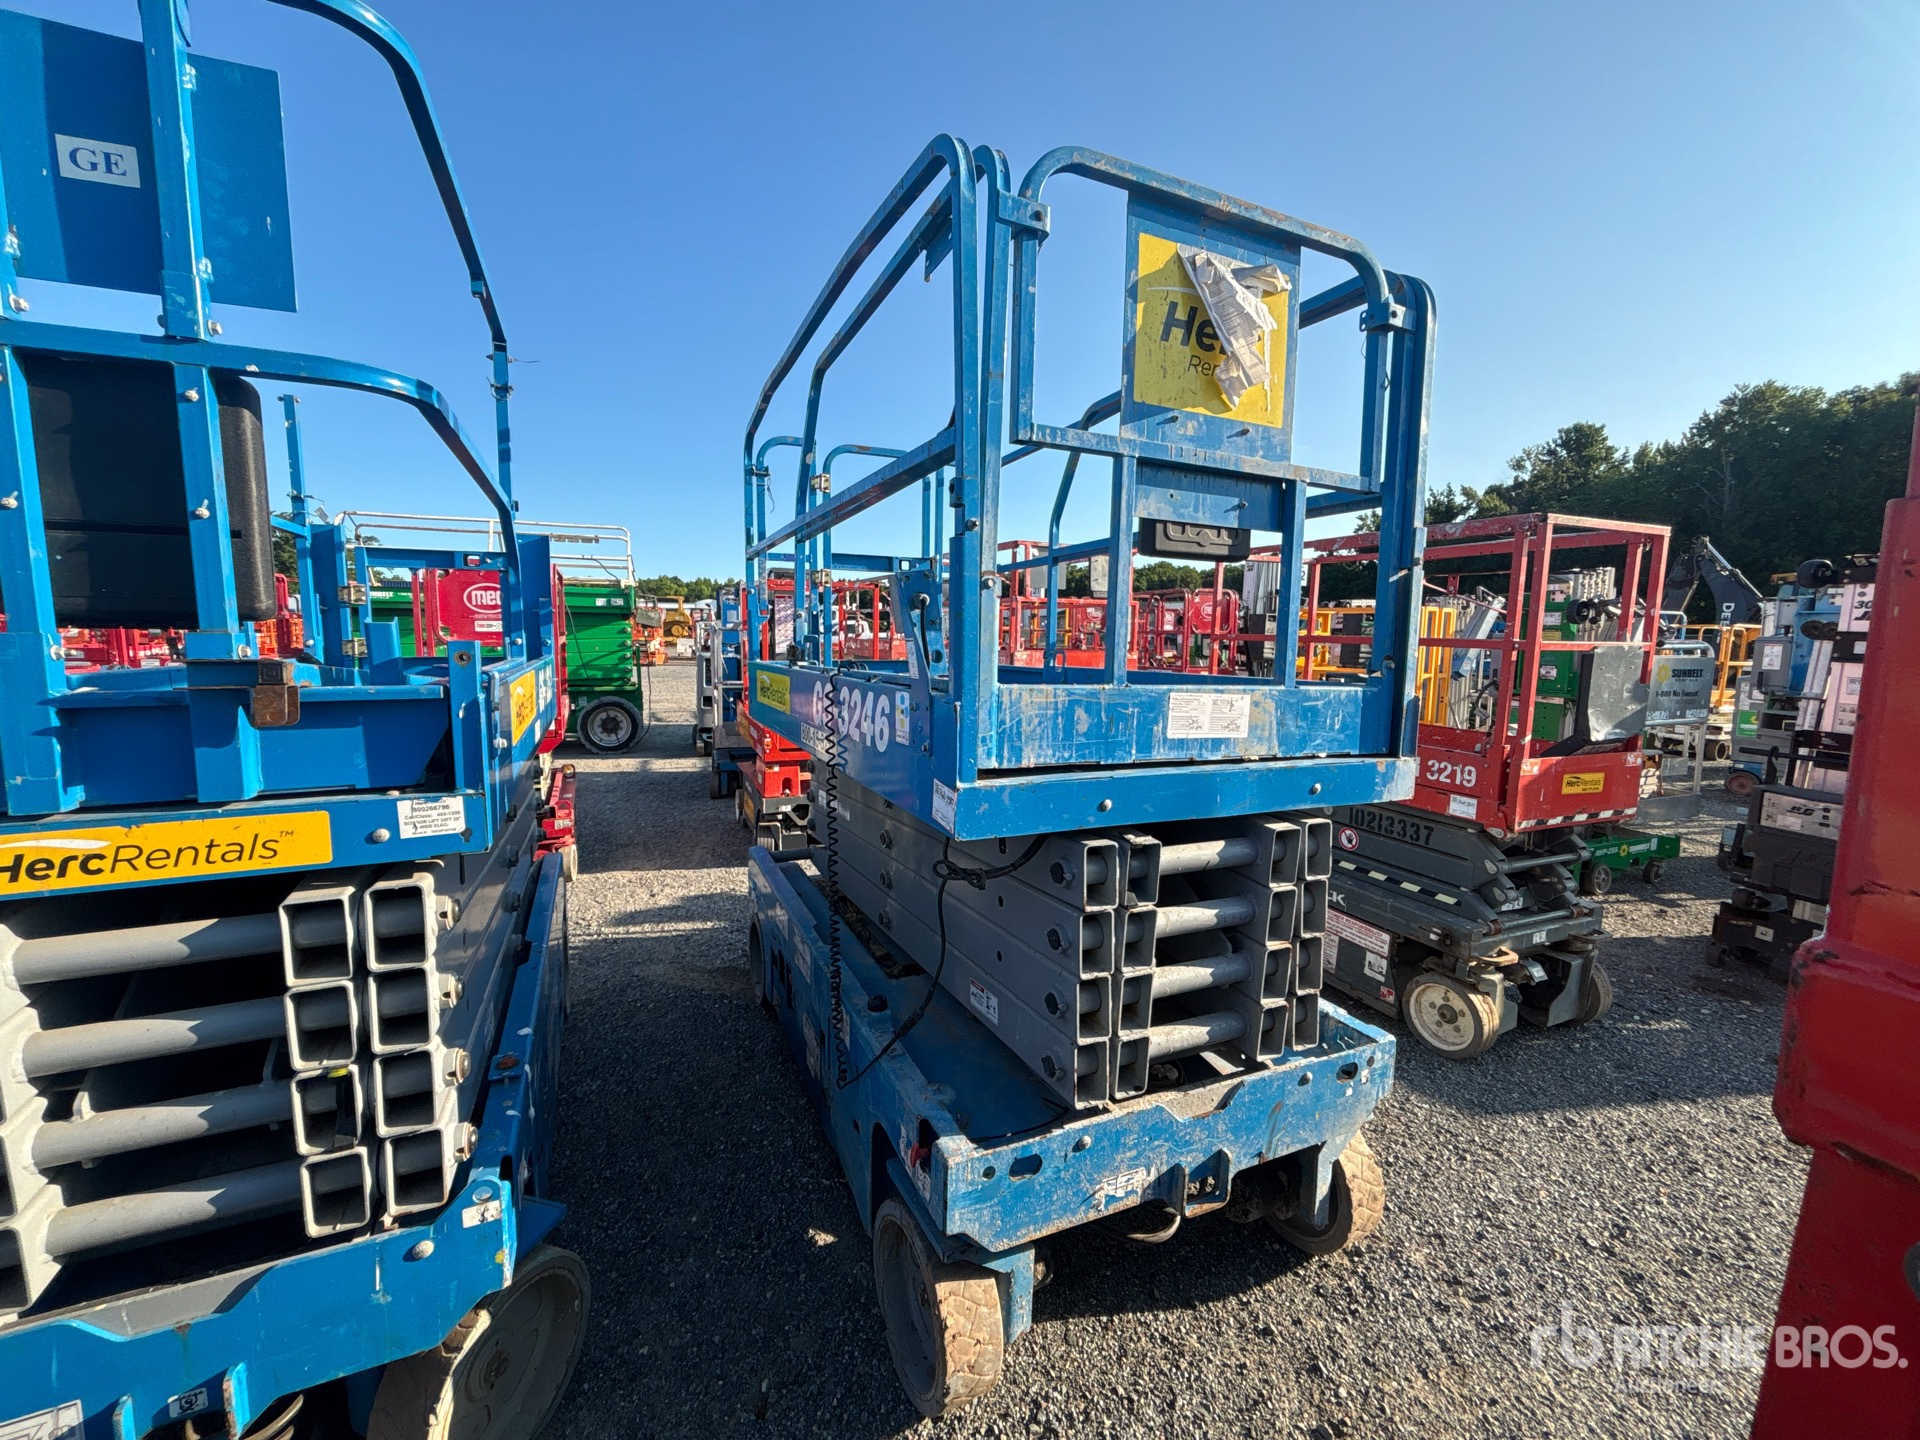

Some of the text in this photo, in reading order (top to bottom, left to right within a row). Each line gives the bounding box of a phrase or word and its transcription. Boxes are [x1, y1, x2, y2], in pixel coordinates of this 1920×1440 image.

[69, 146, 127, 177] GE
[1161, 300, 1228, 355] He
[1671, 668, 1704, 678] SUNBELT
[1681, 689, 1700, 697] Sweat
[1426, 759, 1477, 788] 3219
[1786, 805, 1816, 817] JLG
[1348, 806, 1435, 846] 10213337
